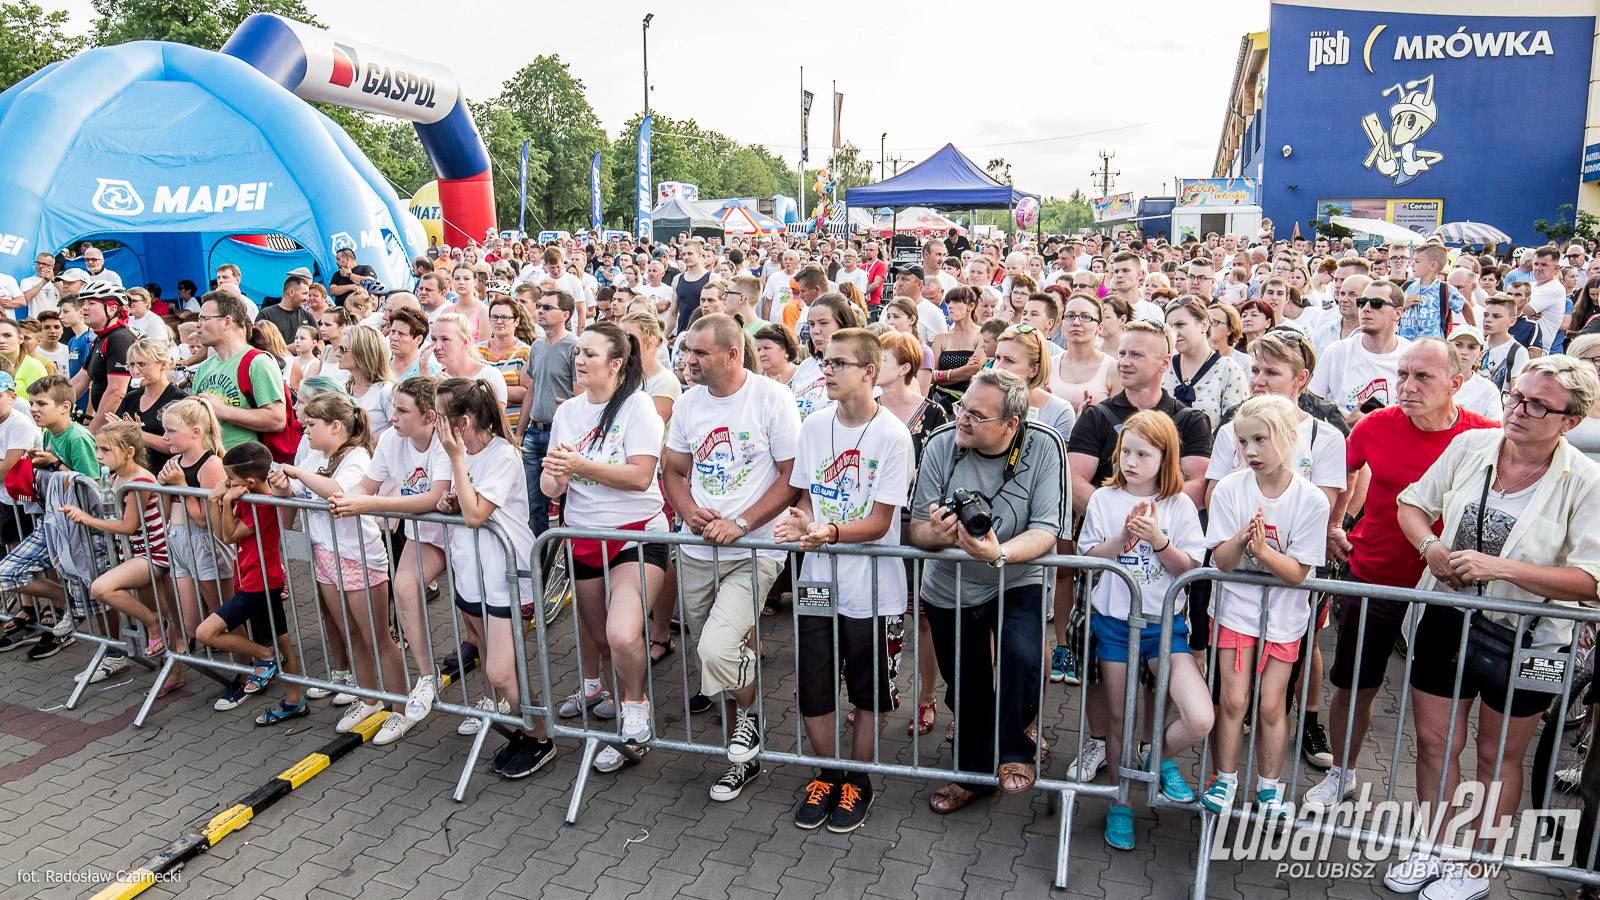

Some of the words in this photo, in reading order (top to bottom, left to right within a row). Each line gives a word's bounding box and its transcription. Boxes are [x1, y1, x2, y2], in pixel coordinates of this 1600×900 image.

[1309, 30, 1350, 72] psb
[1394, 26, 1554, 60] MRÓWKA
[362, 62, 436, 108] GASPOL
[152, 182, 267, 214] MAPEI
[0, 232, 25, 257] EI
[807, 587, 830, 595] SLS
[1533, 657, 1565, 670] SLS
